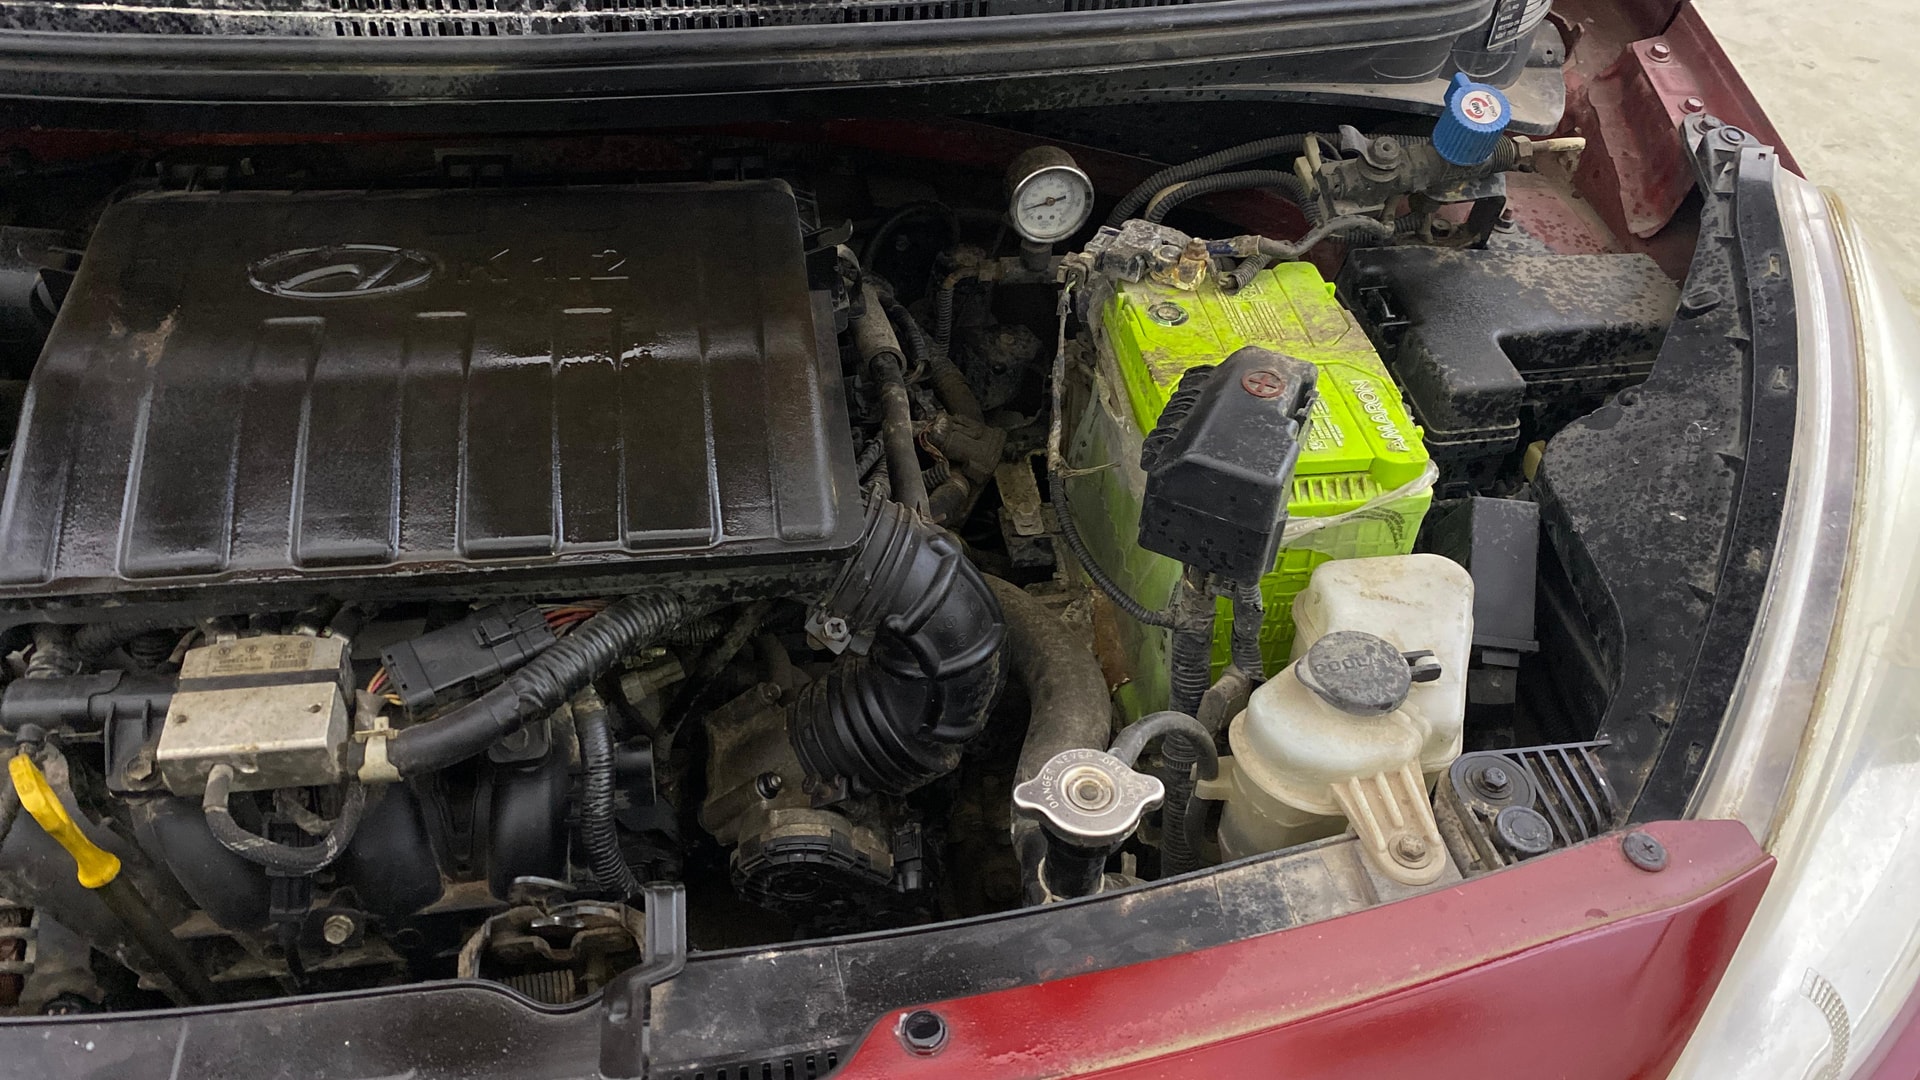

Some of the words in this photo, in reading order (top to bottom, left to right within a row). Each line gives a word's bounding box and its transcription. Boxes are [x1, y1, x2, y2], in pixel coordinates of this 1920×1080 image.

[1351, 379, 1411, 453] AMARON
[1042, 768, 1059, 809] DANGER
[1055, 752, 1093, 765] NEVER
